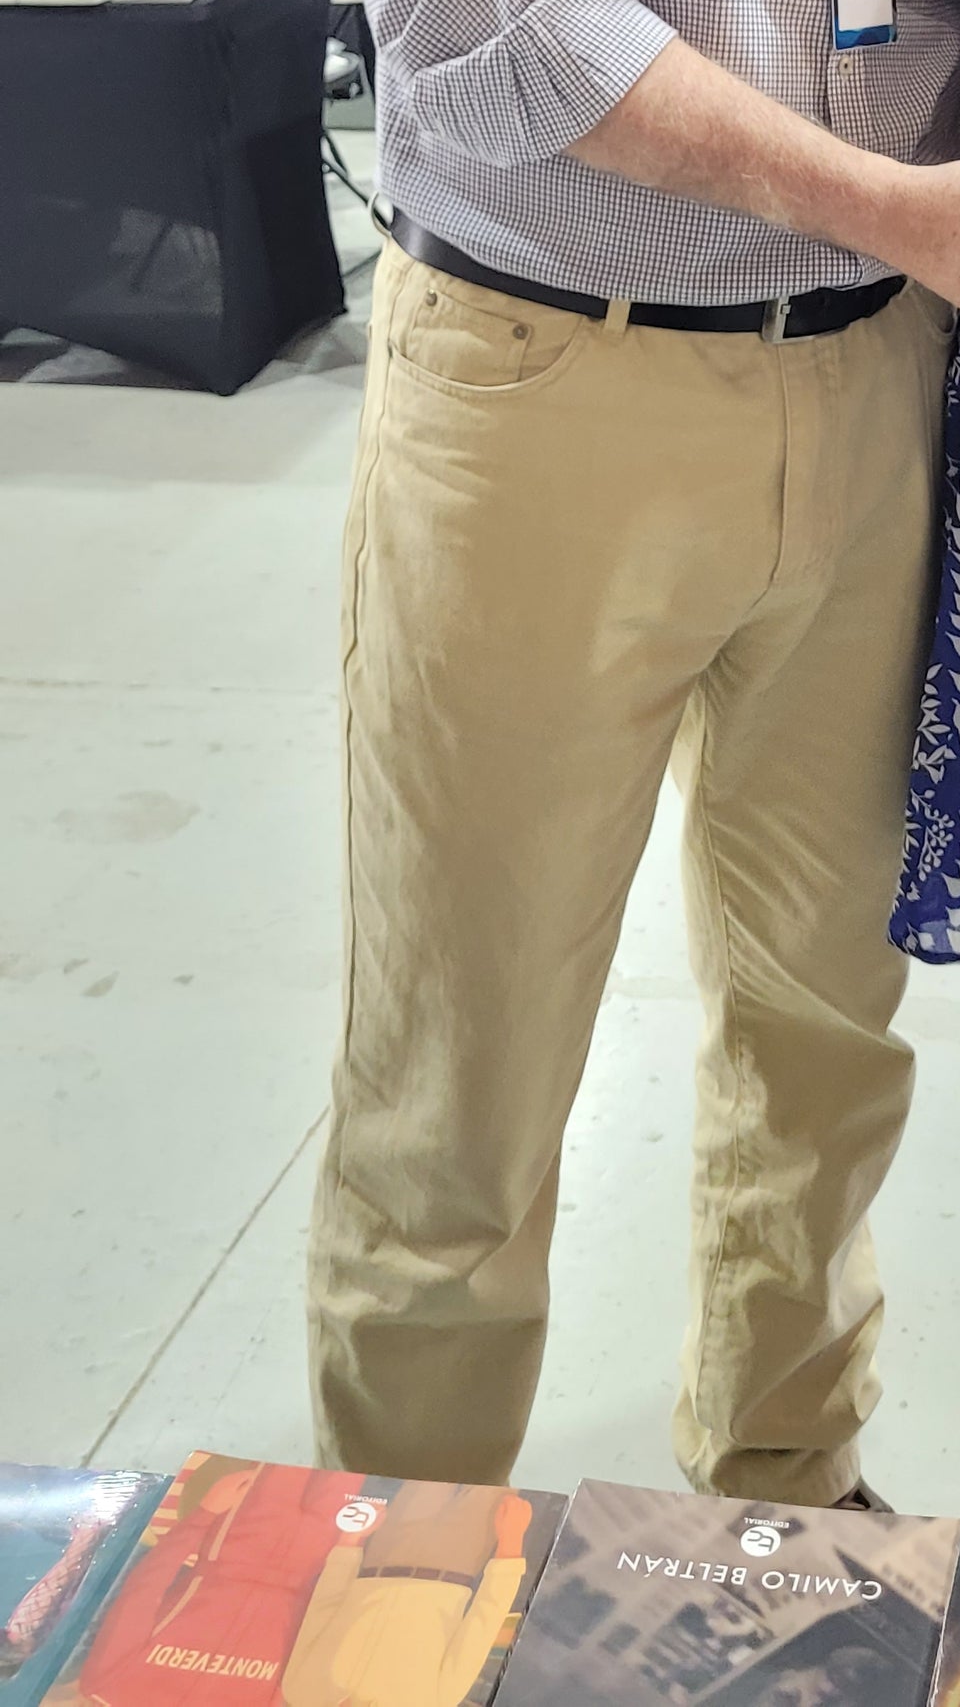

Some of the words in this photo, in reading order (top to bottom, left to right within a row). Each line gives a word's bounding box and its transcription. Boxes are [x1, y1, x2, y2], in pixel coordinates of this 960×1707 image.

[343, 1493, 389, 1506] EDITORIAL
[743, 1516, 790, 1529] EDITORIAL
[616, 1550, 748, 1586] BELTRÁN
[761, 1570, 882, 1601] CAMILO
[145, 1644, 280, 1681] MONTEVERDI
